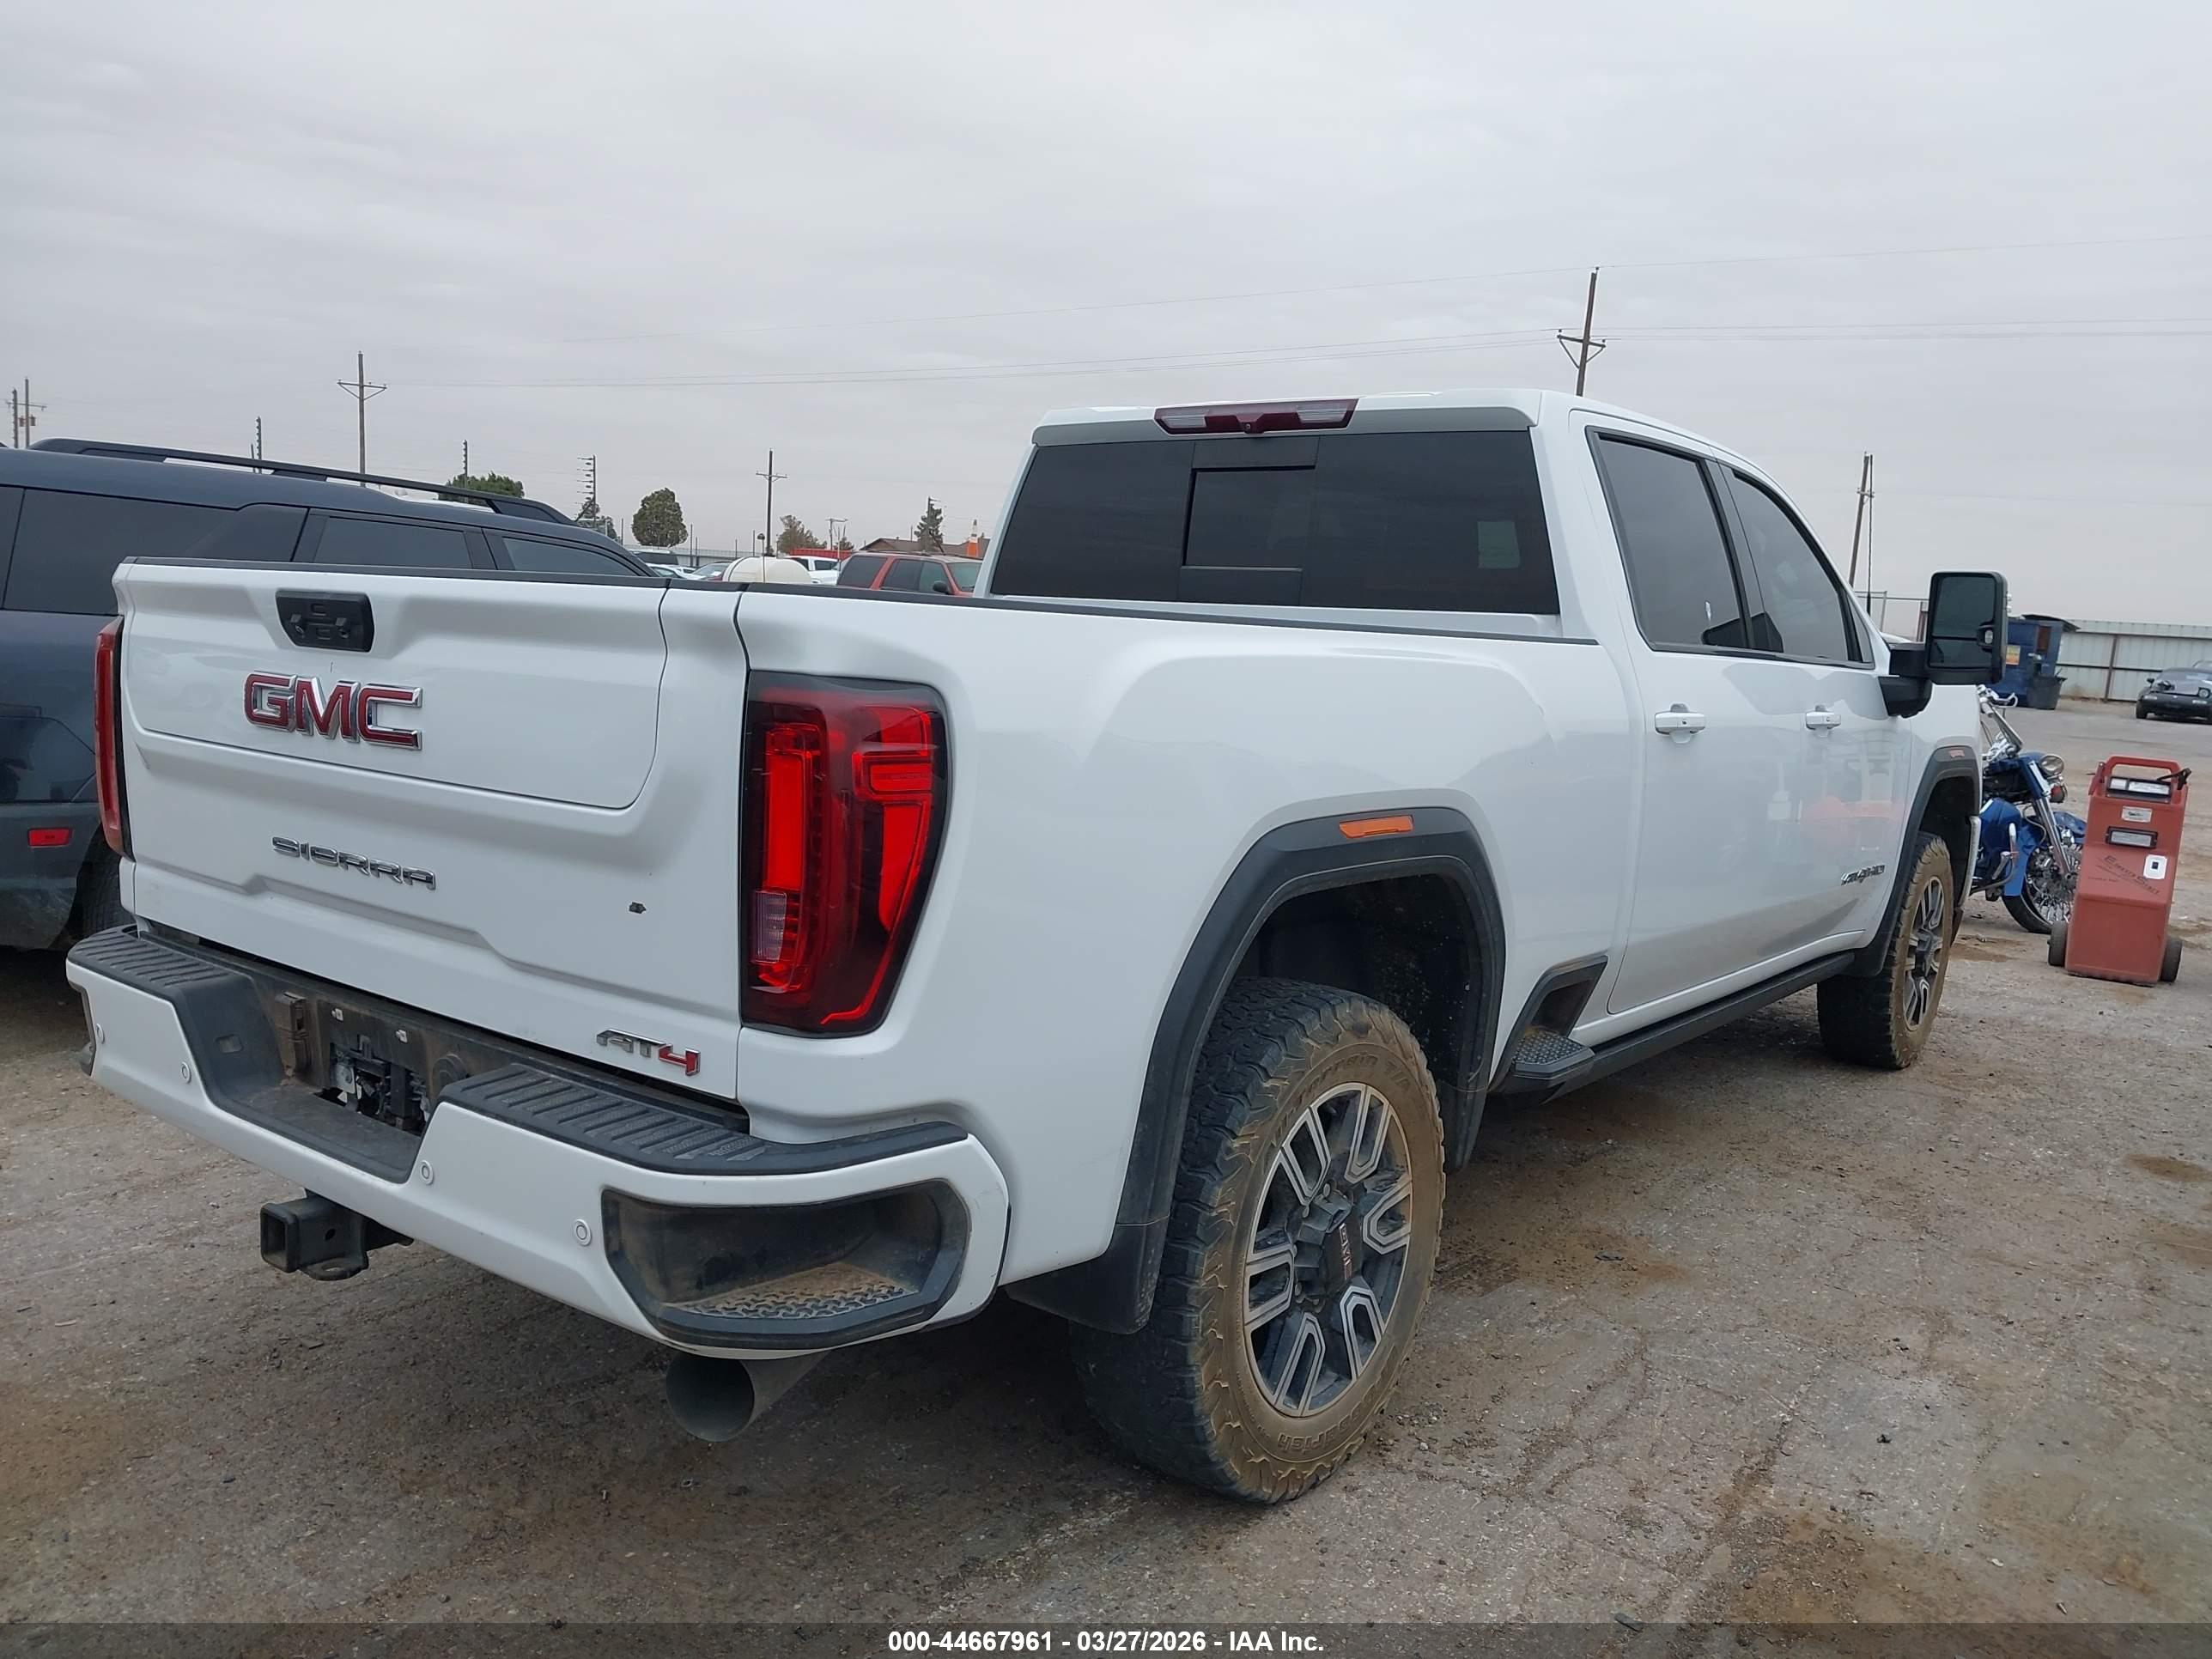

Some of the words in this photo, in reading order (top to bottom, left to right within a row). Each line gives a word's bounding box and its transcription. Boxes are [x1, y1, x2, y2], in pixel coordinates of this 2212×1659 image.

[244, 670, 423, 750] GMC
[272, 836, 436, 890] SIERRA
[596, 1028, 702, 1077] AT4
